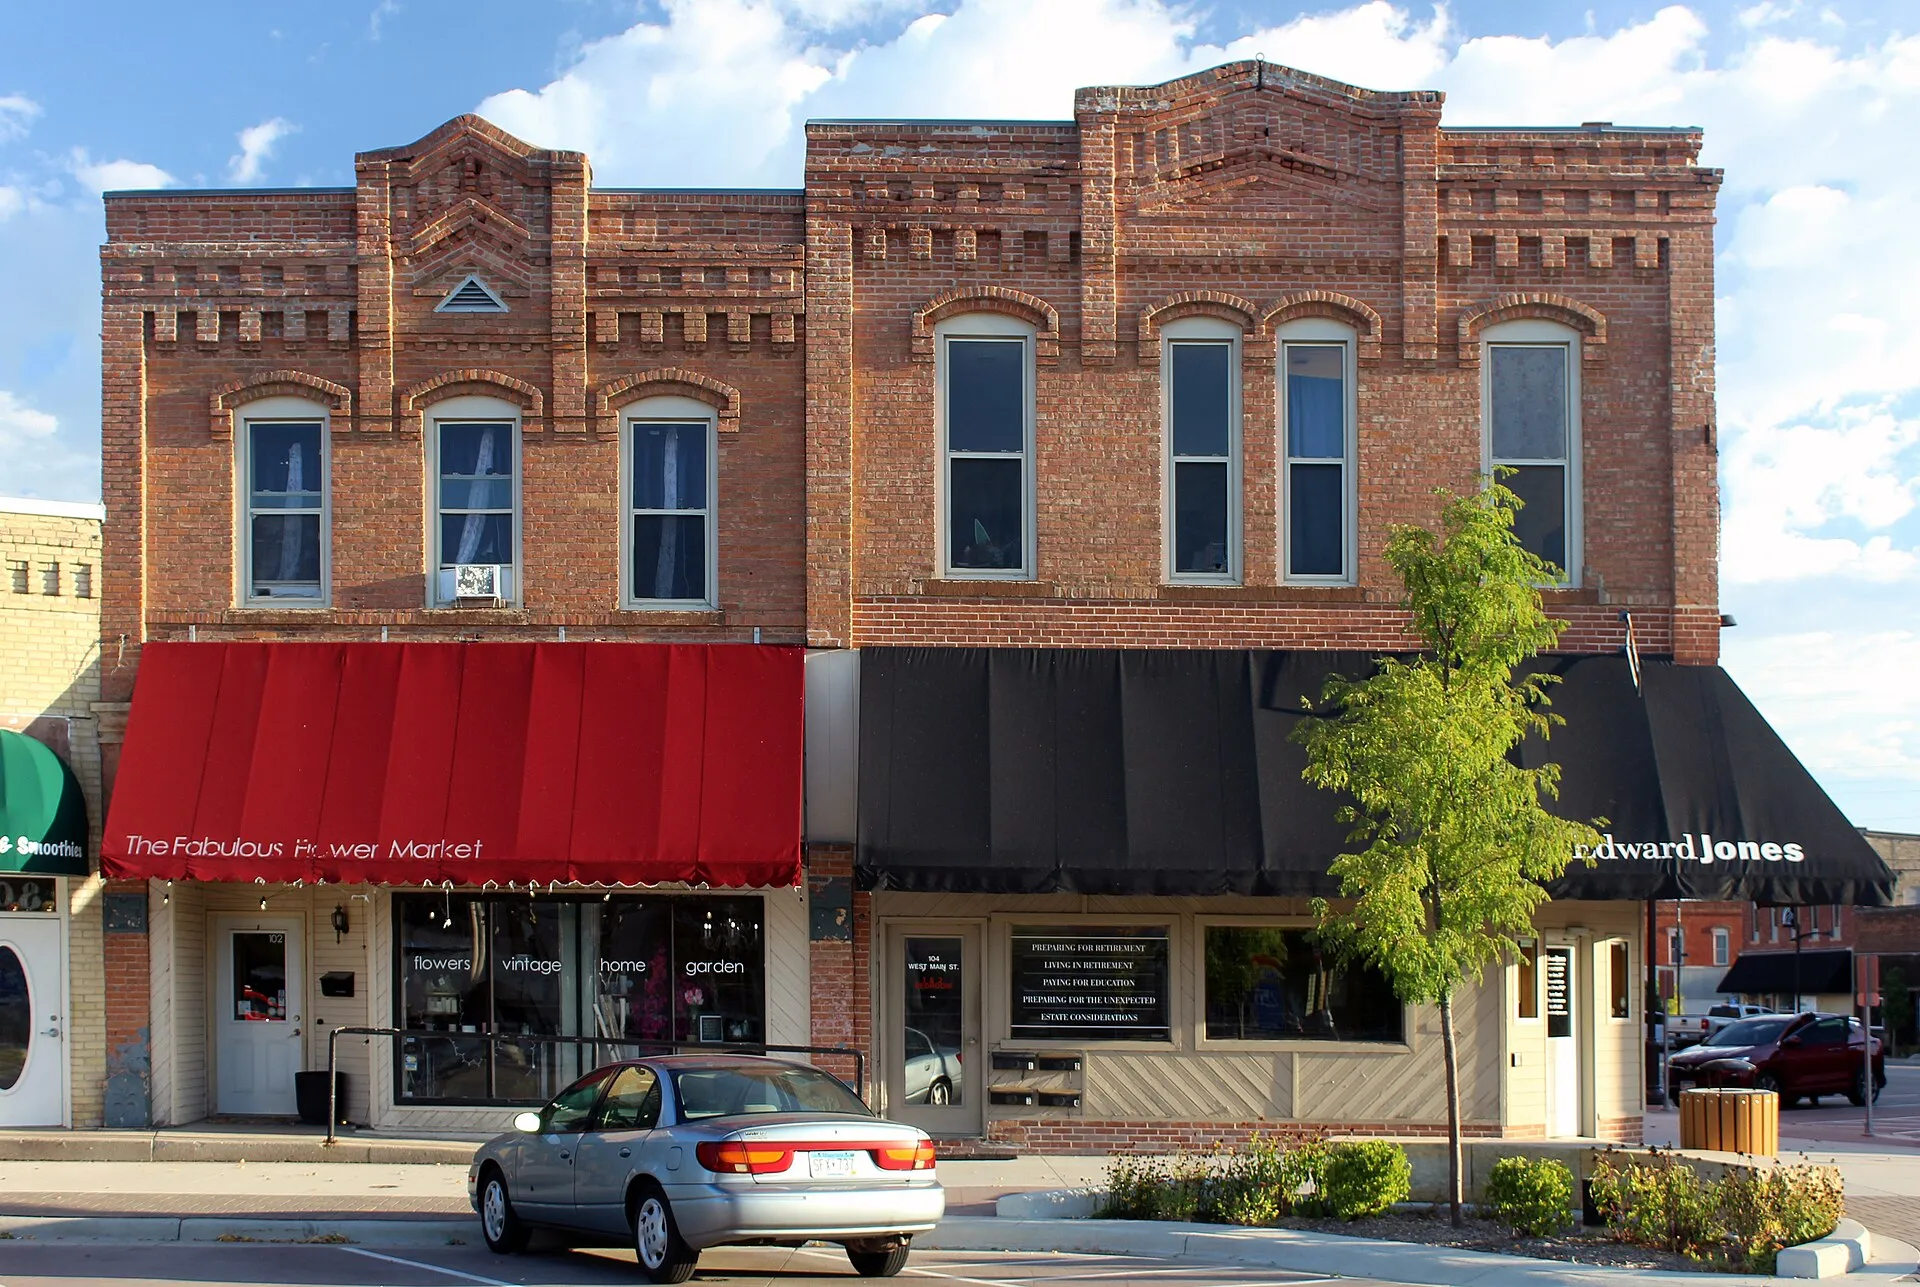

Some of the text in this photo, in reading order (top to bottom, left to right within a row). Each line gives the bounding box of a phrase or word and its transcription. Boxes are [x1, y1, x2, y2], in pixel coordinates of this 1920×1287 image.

[17, 836, 83, 858] Smoothies
[127, 835, 169, 855] The
[172, 836, 284, 858] Fabulous
[388, 839, 484, 859] Market
[1700, 833, 1805, 865] Jones
[269, 934, 283, 944] 102
[1032, 943, 1146, 953] PREPARING FOR RETIREMENT
[414, 955, 471, 971] flowers
[502, 956, 562, 975] vintage
[600, 958, 647, 972] home
[685, 959, 745, 976] garden
[908, 963, 928, 972] WEST
[929, 963, 947, 972] MAIN
[1044, 961, 1071, 969] LIVING
[1083, 961, 1134, 970] RETIREMENT
[1043, 978, 1136, 987] PAYING FOR EDUCATION
[1023, 996, 1156, 1005] PREPARING FOR THE UNEXPECTED
[1041, 1013, 1138, 1022] ESTATE CONSIDERATIONS
